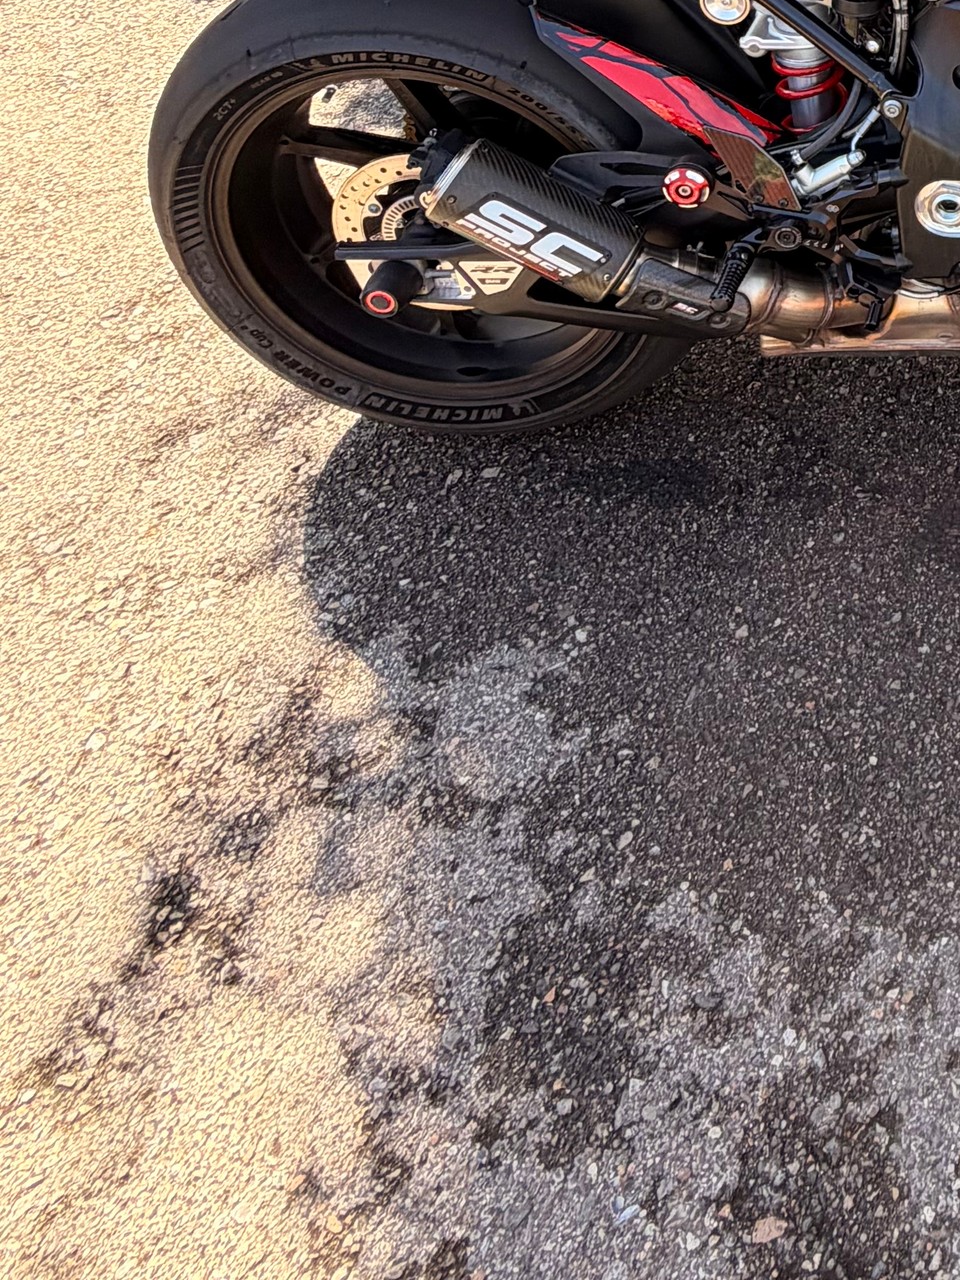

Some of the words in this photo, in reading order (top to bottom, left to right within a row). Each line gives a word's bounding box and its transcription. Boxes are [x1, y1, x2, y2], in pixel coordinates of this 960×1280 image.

[331, 52, 487, 82] MICHELIN
[455, 218, 575, 278] PROJECT
[463, 199, 604, 277] SC
[273, 350, 353, 396] POWER
[364, 394, 504, 421] MICHELIN
